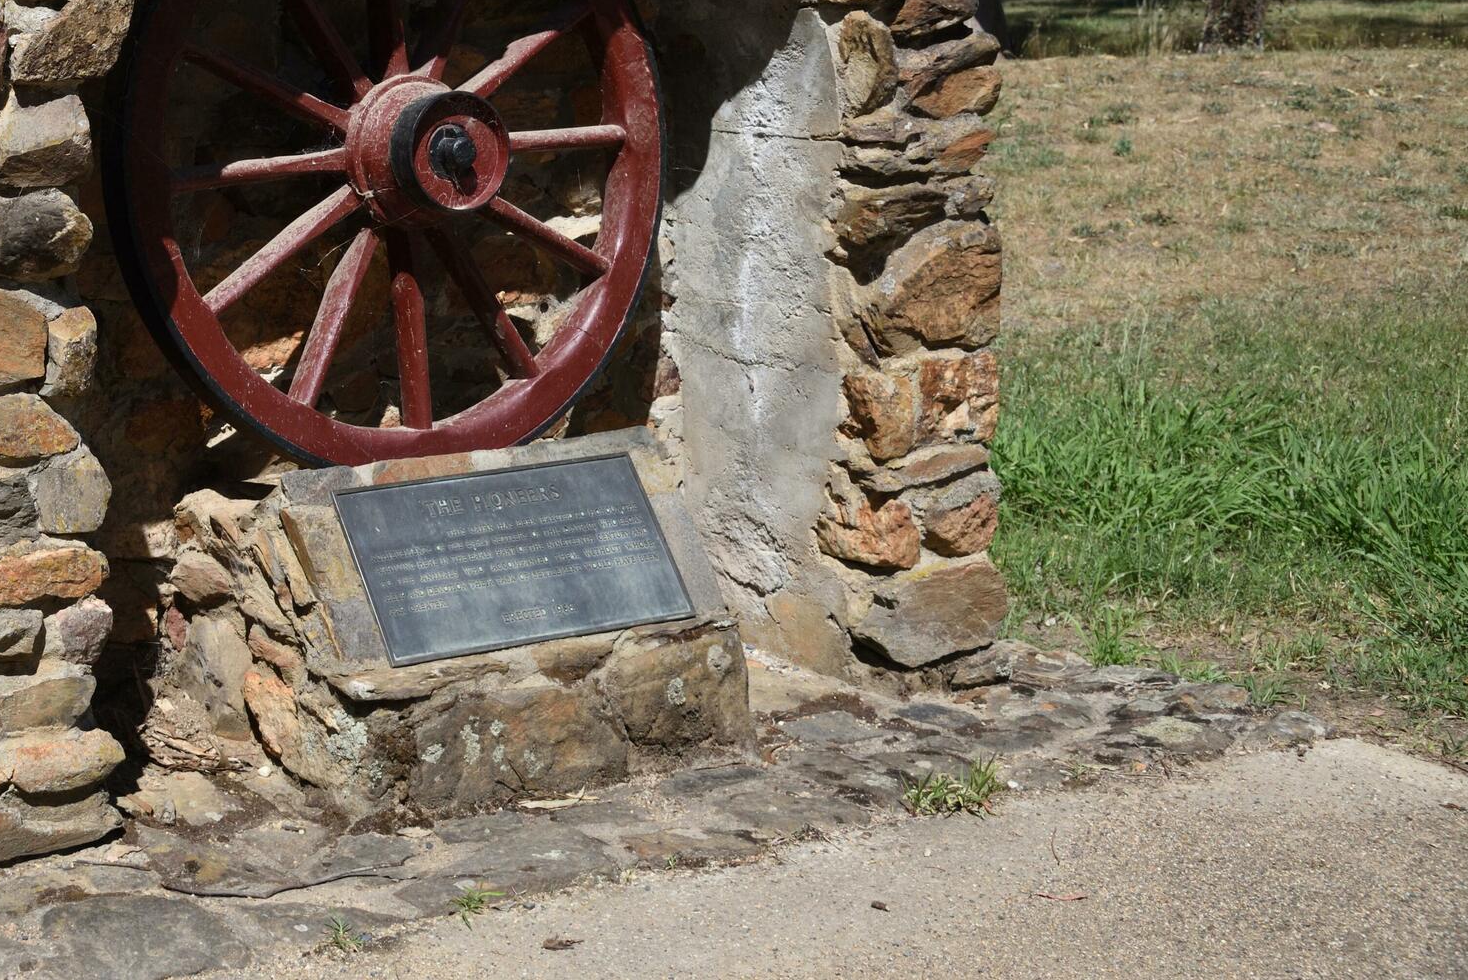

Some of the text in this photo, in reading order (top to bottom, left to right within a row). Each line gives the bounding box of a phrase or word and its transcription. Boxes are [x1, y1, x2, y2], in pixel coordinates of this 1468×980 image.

[424, 484, 561, 517] THE PIONEERS
[597, 531, 628, 541] CENTURY
[583, 545, 621, 557] WITHOUT
[625, 540, 653, 550] WHOSE
[614, 556, 636, 566] HAVE
[501, 607, 547, 623] ERECTED
